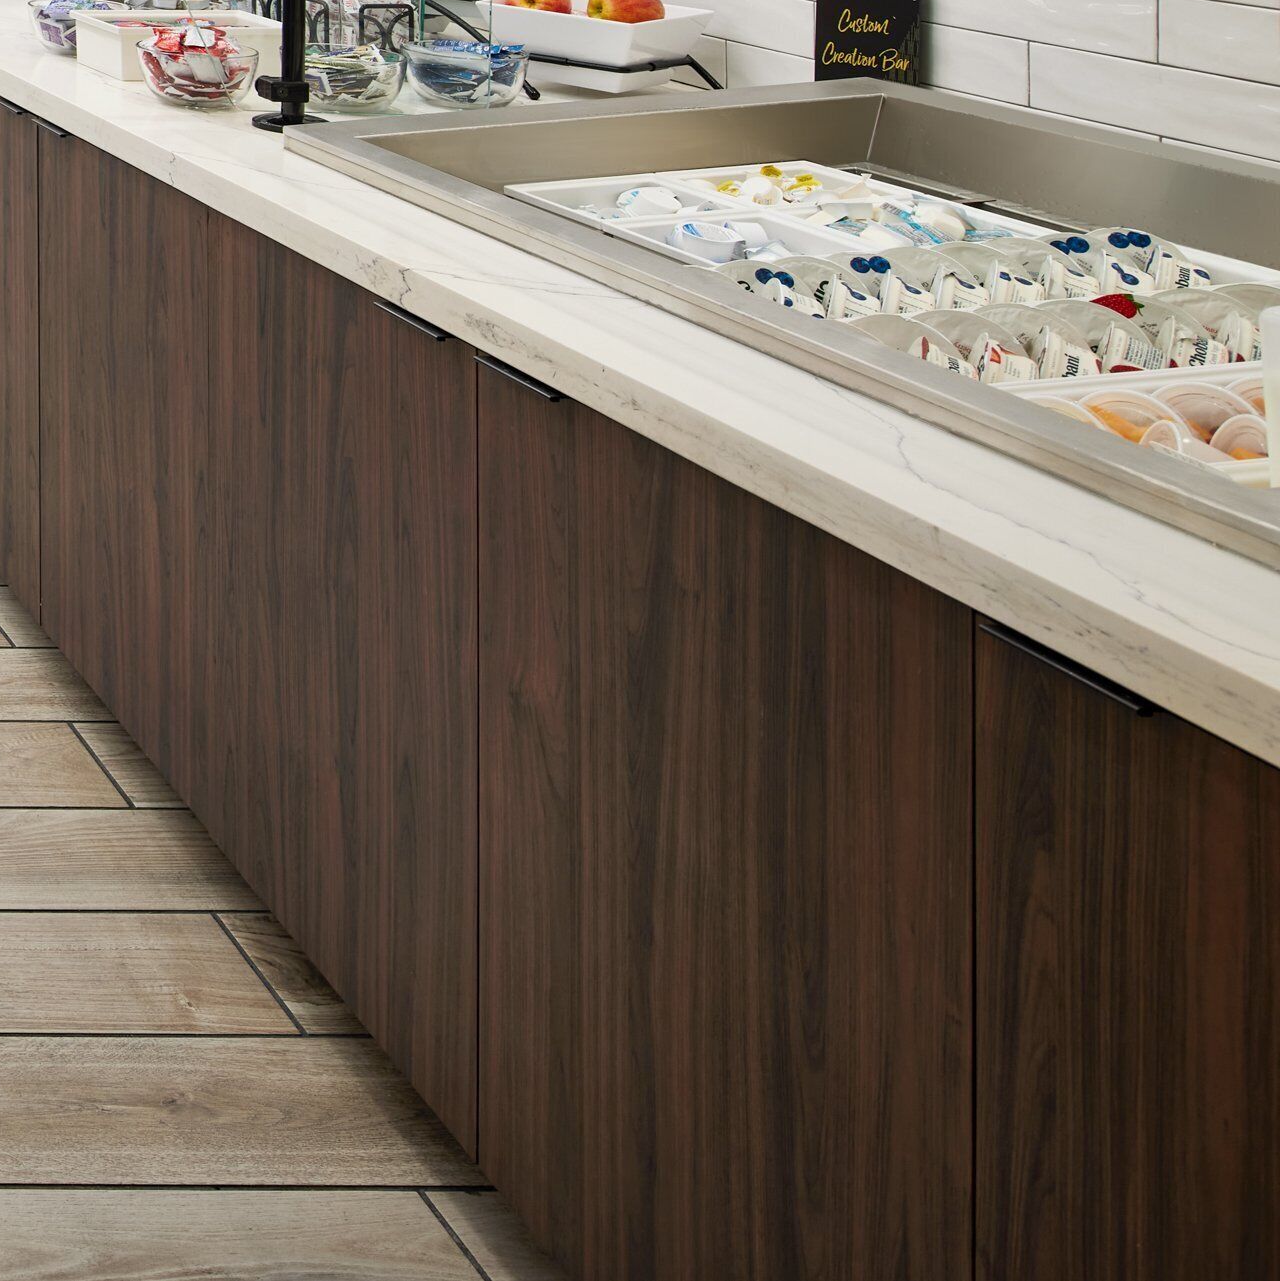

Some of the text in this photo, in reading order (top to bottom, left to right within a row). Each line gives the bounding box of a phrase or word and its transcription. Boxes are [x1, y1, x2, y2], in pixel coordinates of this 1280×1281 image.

[838, 8, 890, 35] Custom
[822, 41, 910, 72] Creation Bar
